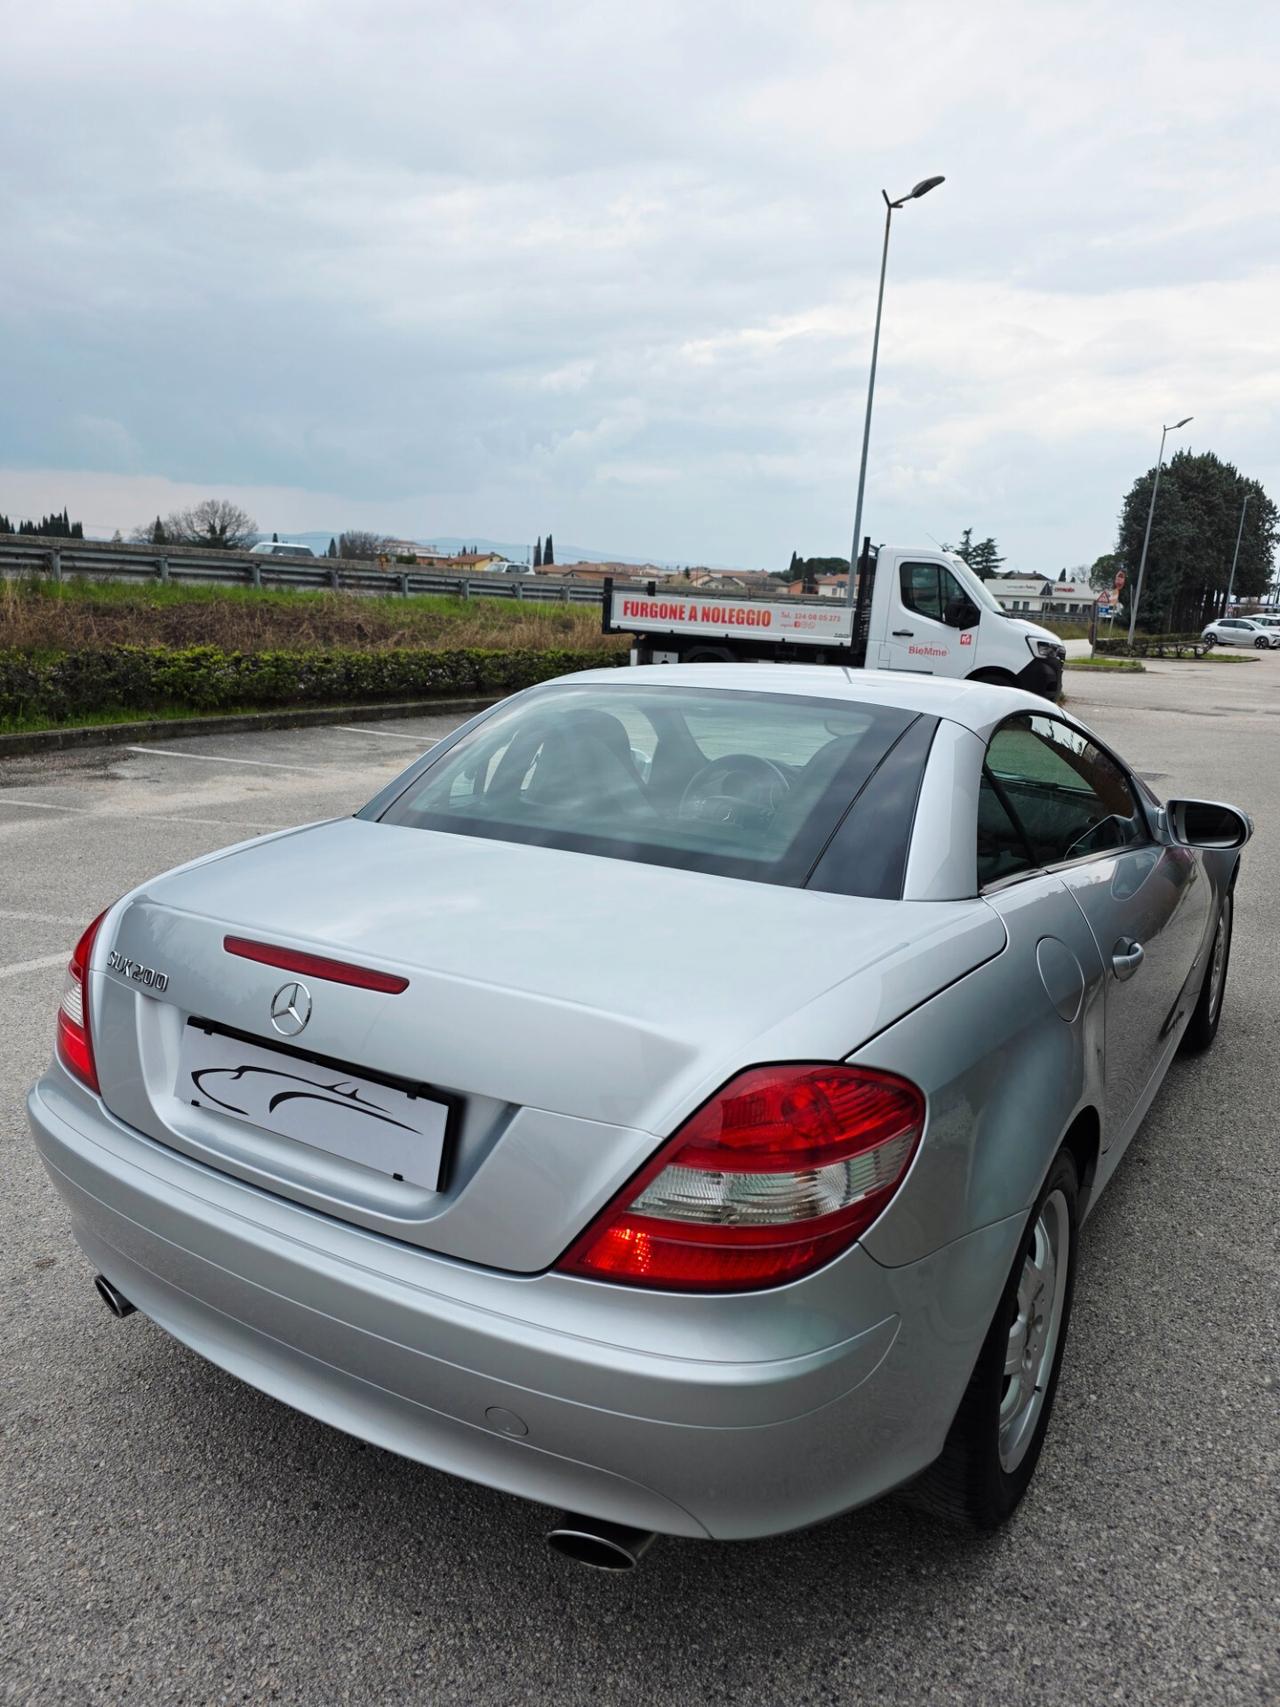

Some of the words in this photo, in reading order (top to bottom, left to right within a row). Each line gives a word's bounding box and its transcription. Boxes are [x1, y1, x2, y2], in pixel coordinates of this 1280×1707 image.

[623, 600, 685, 620] FURGONE
[688, 604, 698, 622] A
[701, 606, 772, 627] NOLEGGIO
